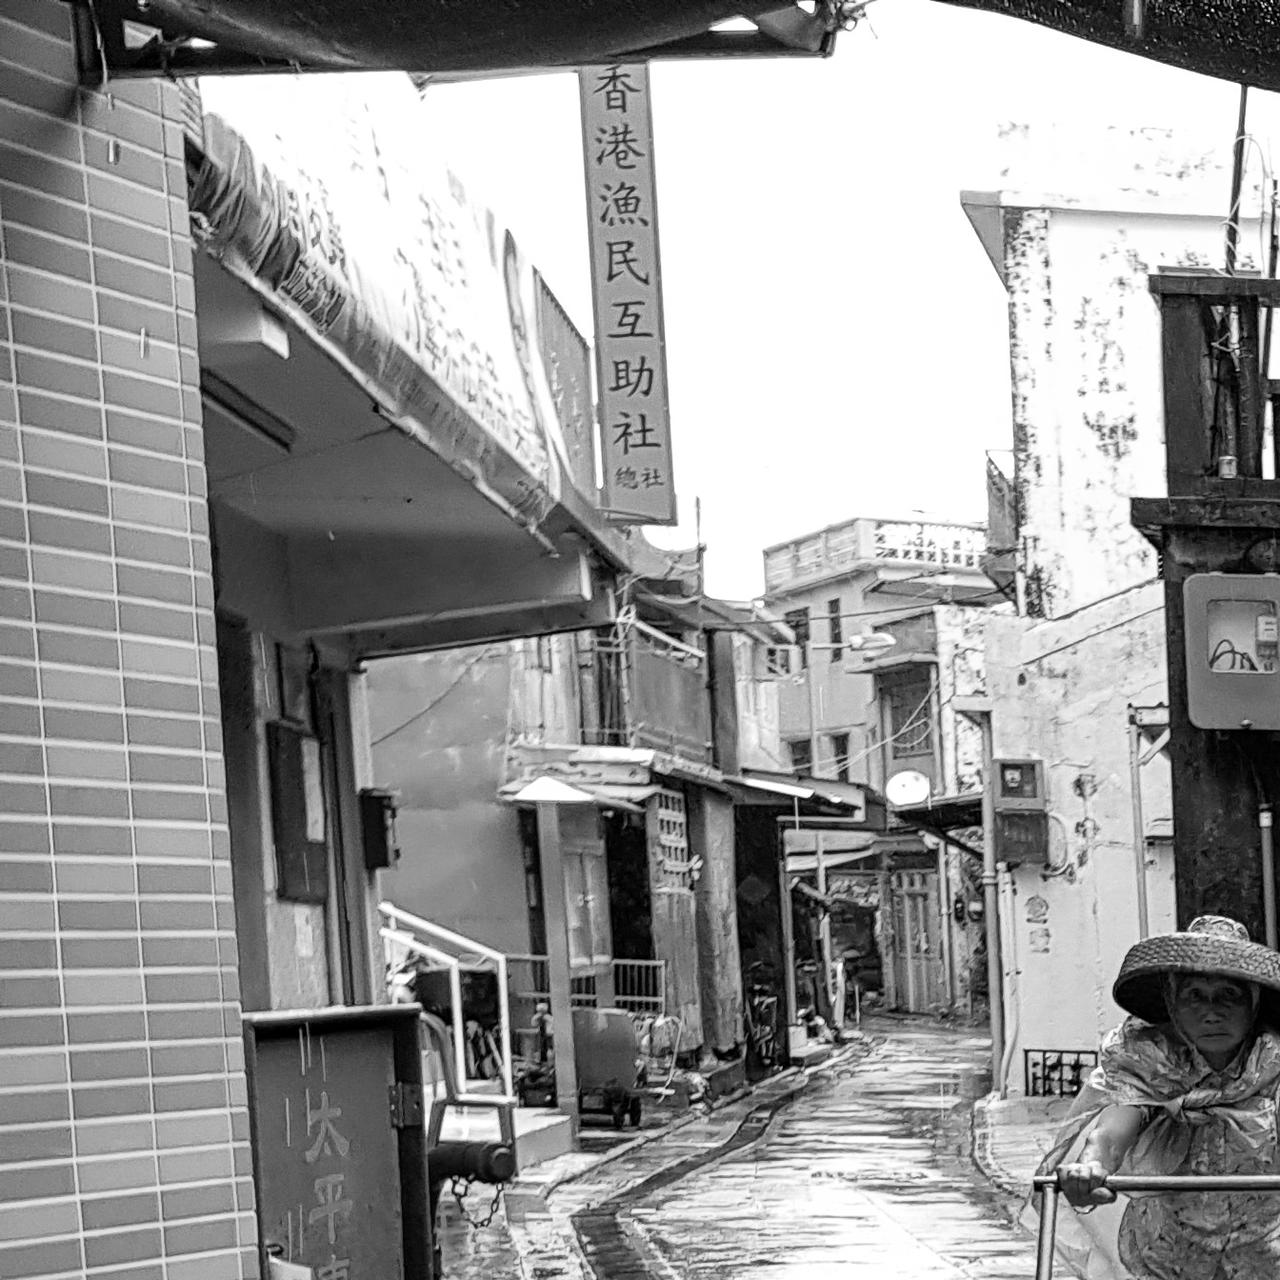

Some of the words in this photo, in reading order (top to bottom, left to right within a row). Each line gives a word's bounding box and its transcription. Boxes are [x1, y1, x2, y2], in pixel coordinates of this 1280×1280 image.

[593, 65, 662, 455] 香港漁民互助社
